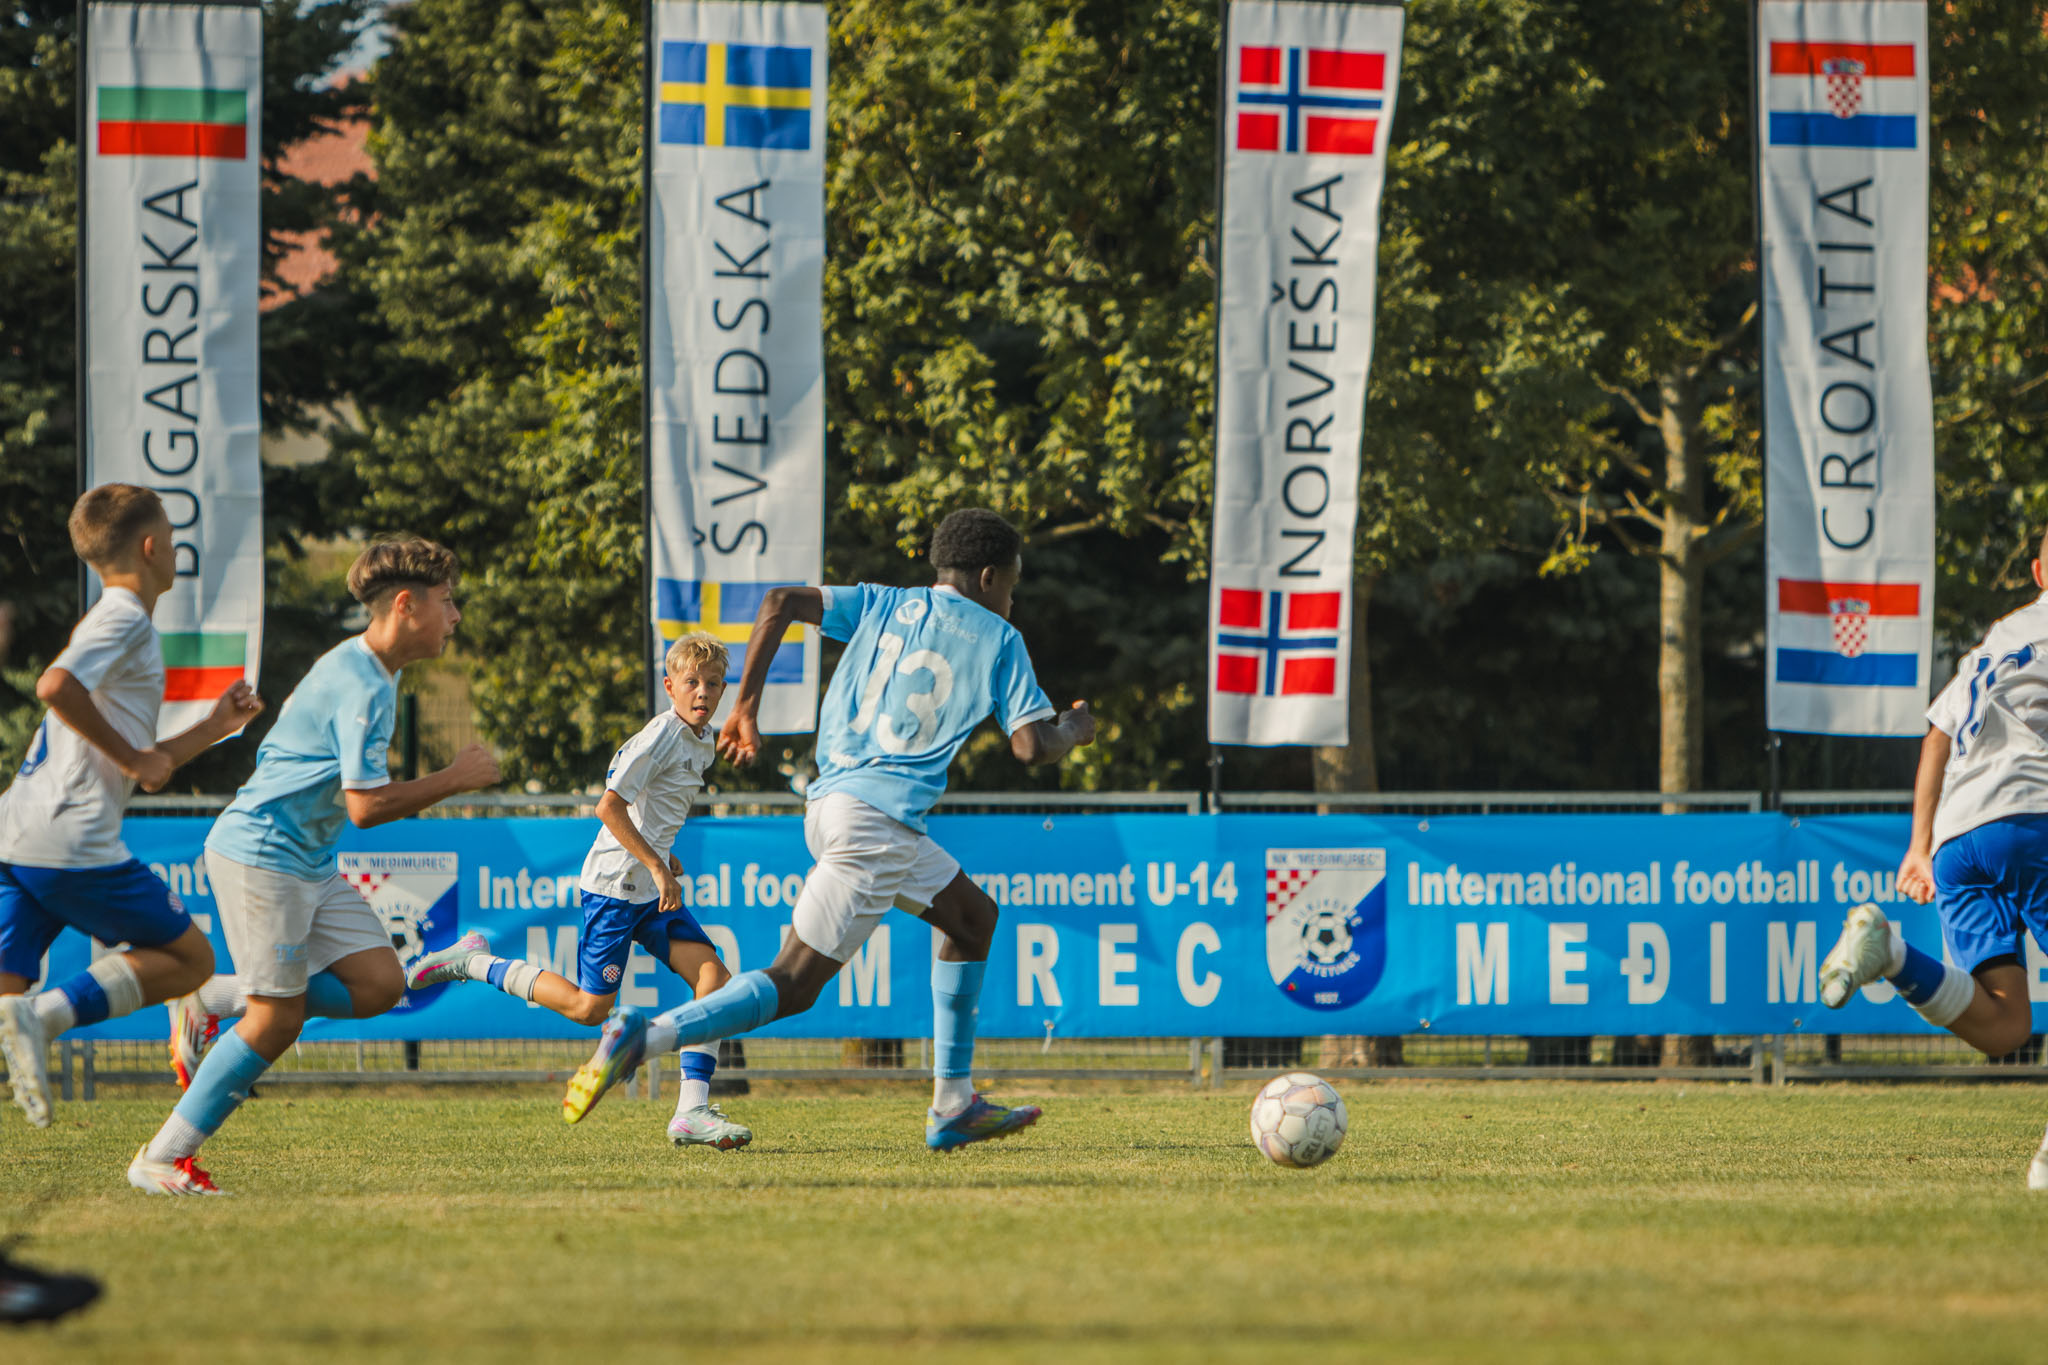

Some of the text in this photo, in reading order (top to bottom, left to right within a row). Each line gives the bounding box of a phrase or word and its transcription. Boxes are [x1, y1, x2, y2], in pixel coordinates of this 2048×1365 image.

[691, 179, 770, 555] ŠVEDSKA
[1272, 174, 1344, 578] NORVEŠKA
[1816, 177, 1876, 551] CROATIA
[848, 632, 953, 755] 13
[1147, 861, 1239, 906] U-14
[1408, 861, 1661, 906] International
[1672, 860, 1819, 904] football
[1300, 1114, 1330, 1160] SELECT
